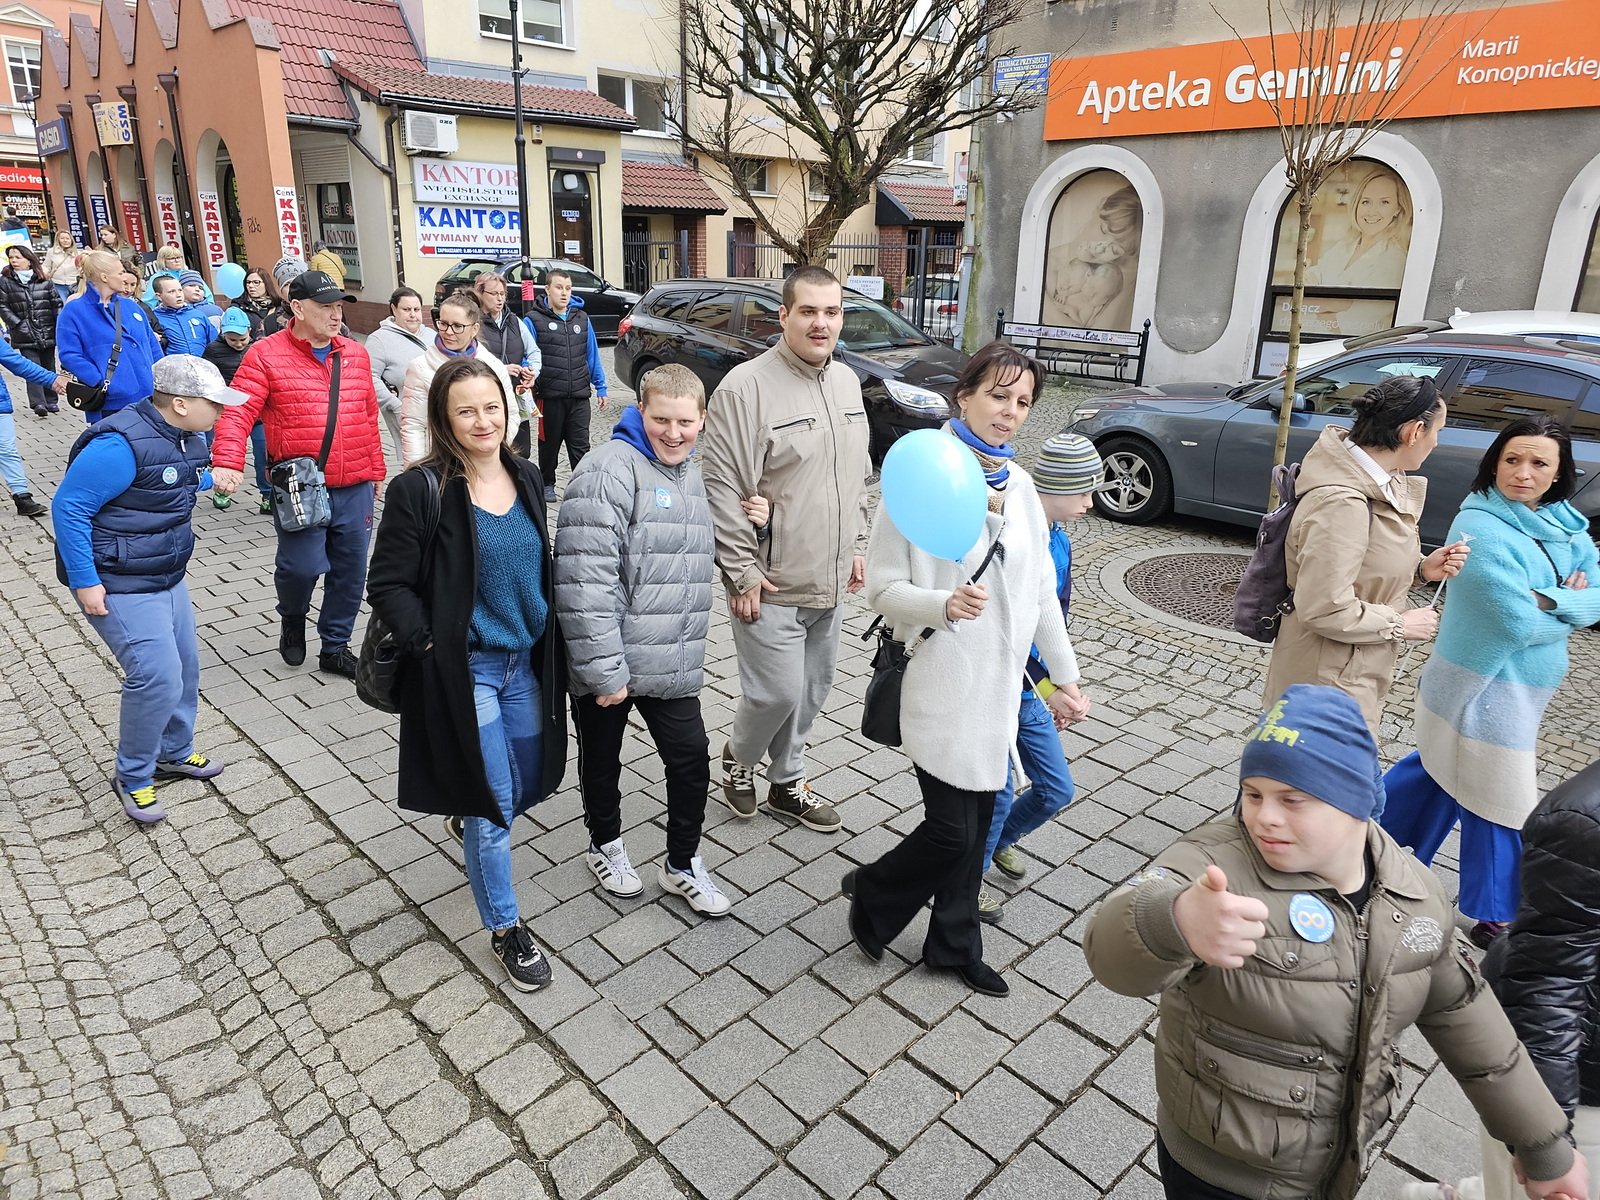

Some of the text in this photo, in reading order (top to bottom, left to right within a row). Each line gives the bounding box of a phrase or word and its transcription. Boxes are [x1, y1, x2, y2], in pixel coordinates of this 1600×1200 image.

[1462, 35, 1520, 59] Marii
[1077, 47, 1404, 124] Apteka Gemini
[117, 104, 131, 142] GSM
[39, 126, 60, 150] CASIO
[422, 164, 518, 187] KANTOR
[444, 194, 503, 203] EXCHANGE
[418, 206, 521, 230] KANTOR
[421, 233, 478, 243] WYMIANY
[1282, 302, 1321, 315] Dącz
[286, 462, 307, 526] DIESEL
